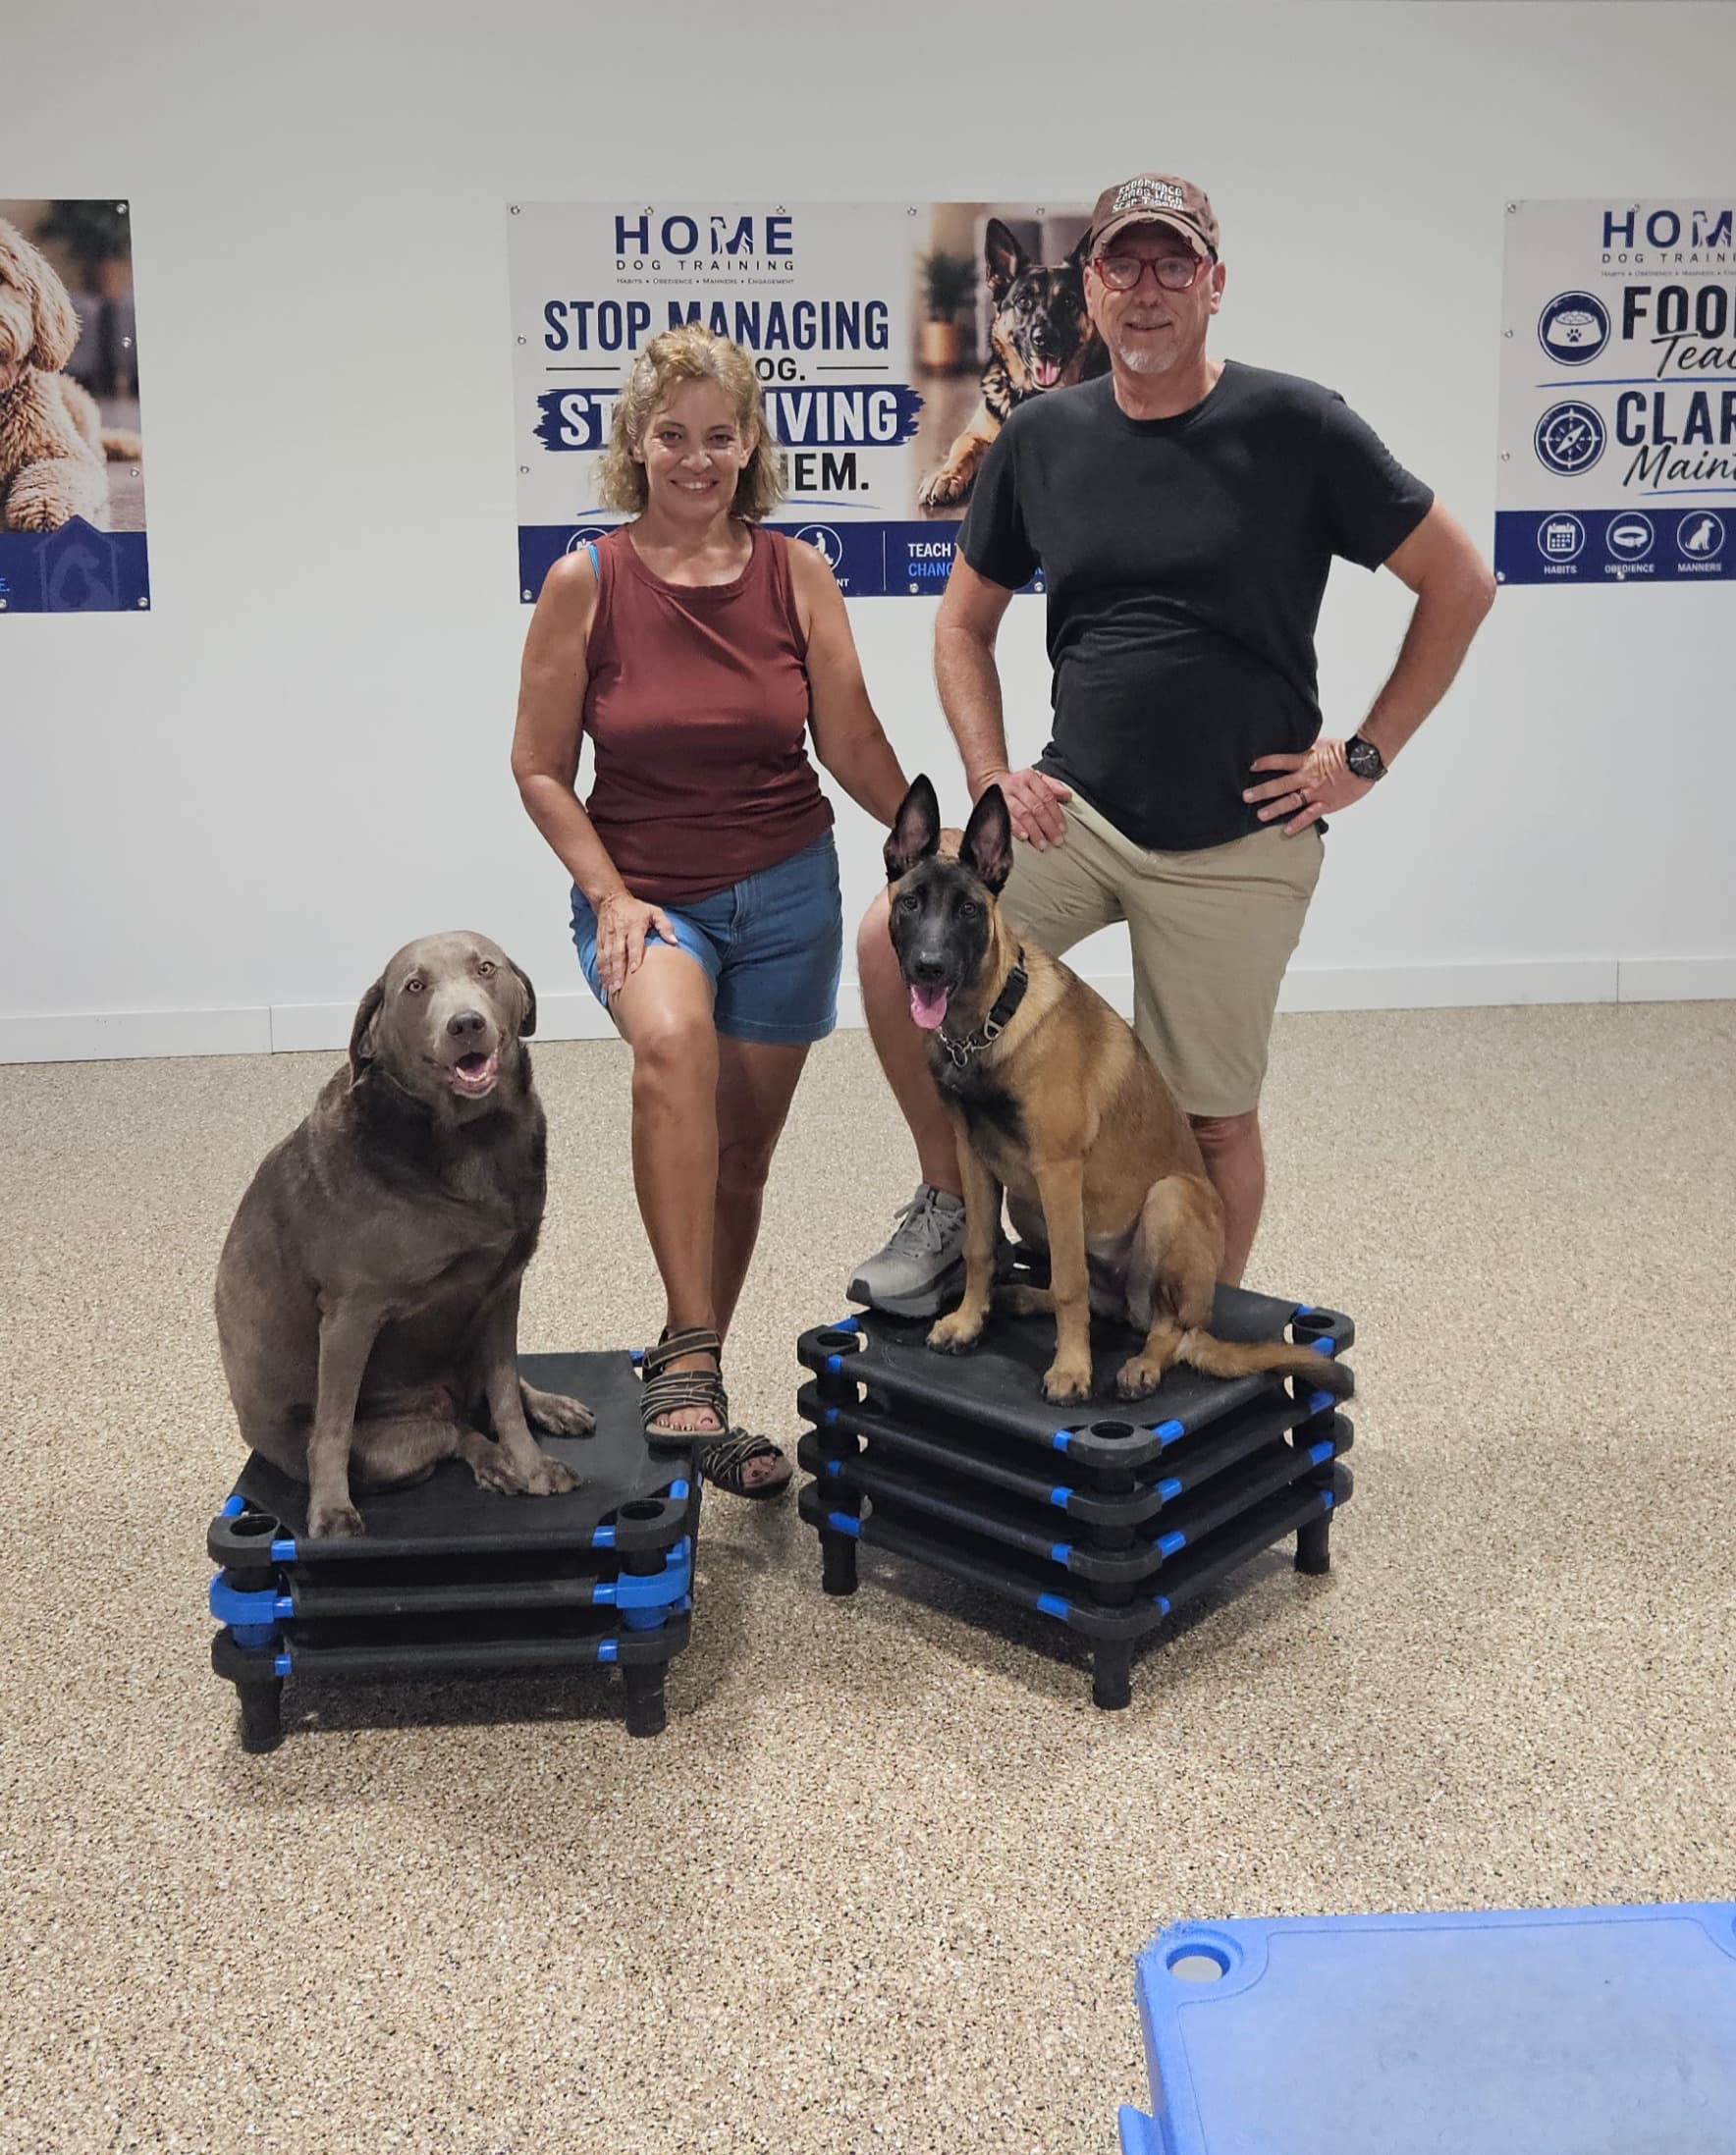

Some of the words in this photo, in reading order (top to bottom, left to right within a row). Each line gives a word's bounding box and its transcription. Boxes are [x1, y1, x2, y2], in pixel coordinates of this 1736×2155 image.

[615, 215, 793, 255] HOME
[617, 259, 661, 271] DOG
[678, 259, 794, 271] TRAINING
[1601, 252, 1644, 264] DOG
[544, 300, 651, 351] STOP
[754, 357, 805, 381] OG.
[765, 390, 897, 443] IVING
[781, 452, 870, 492] EM.
[907, 543, 951, 558] TEACH
[1544, 565, 1578, 574] HABITS
[1604, 563, 1655, 574] OBEDIENCE
[1677, 563, 1722, 572] MANNERS
